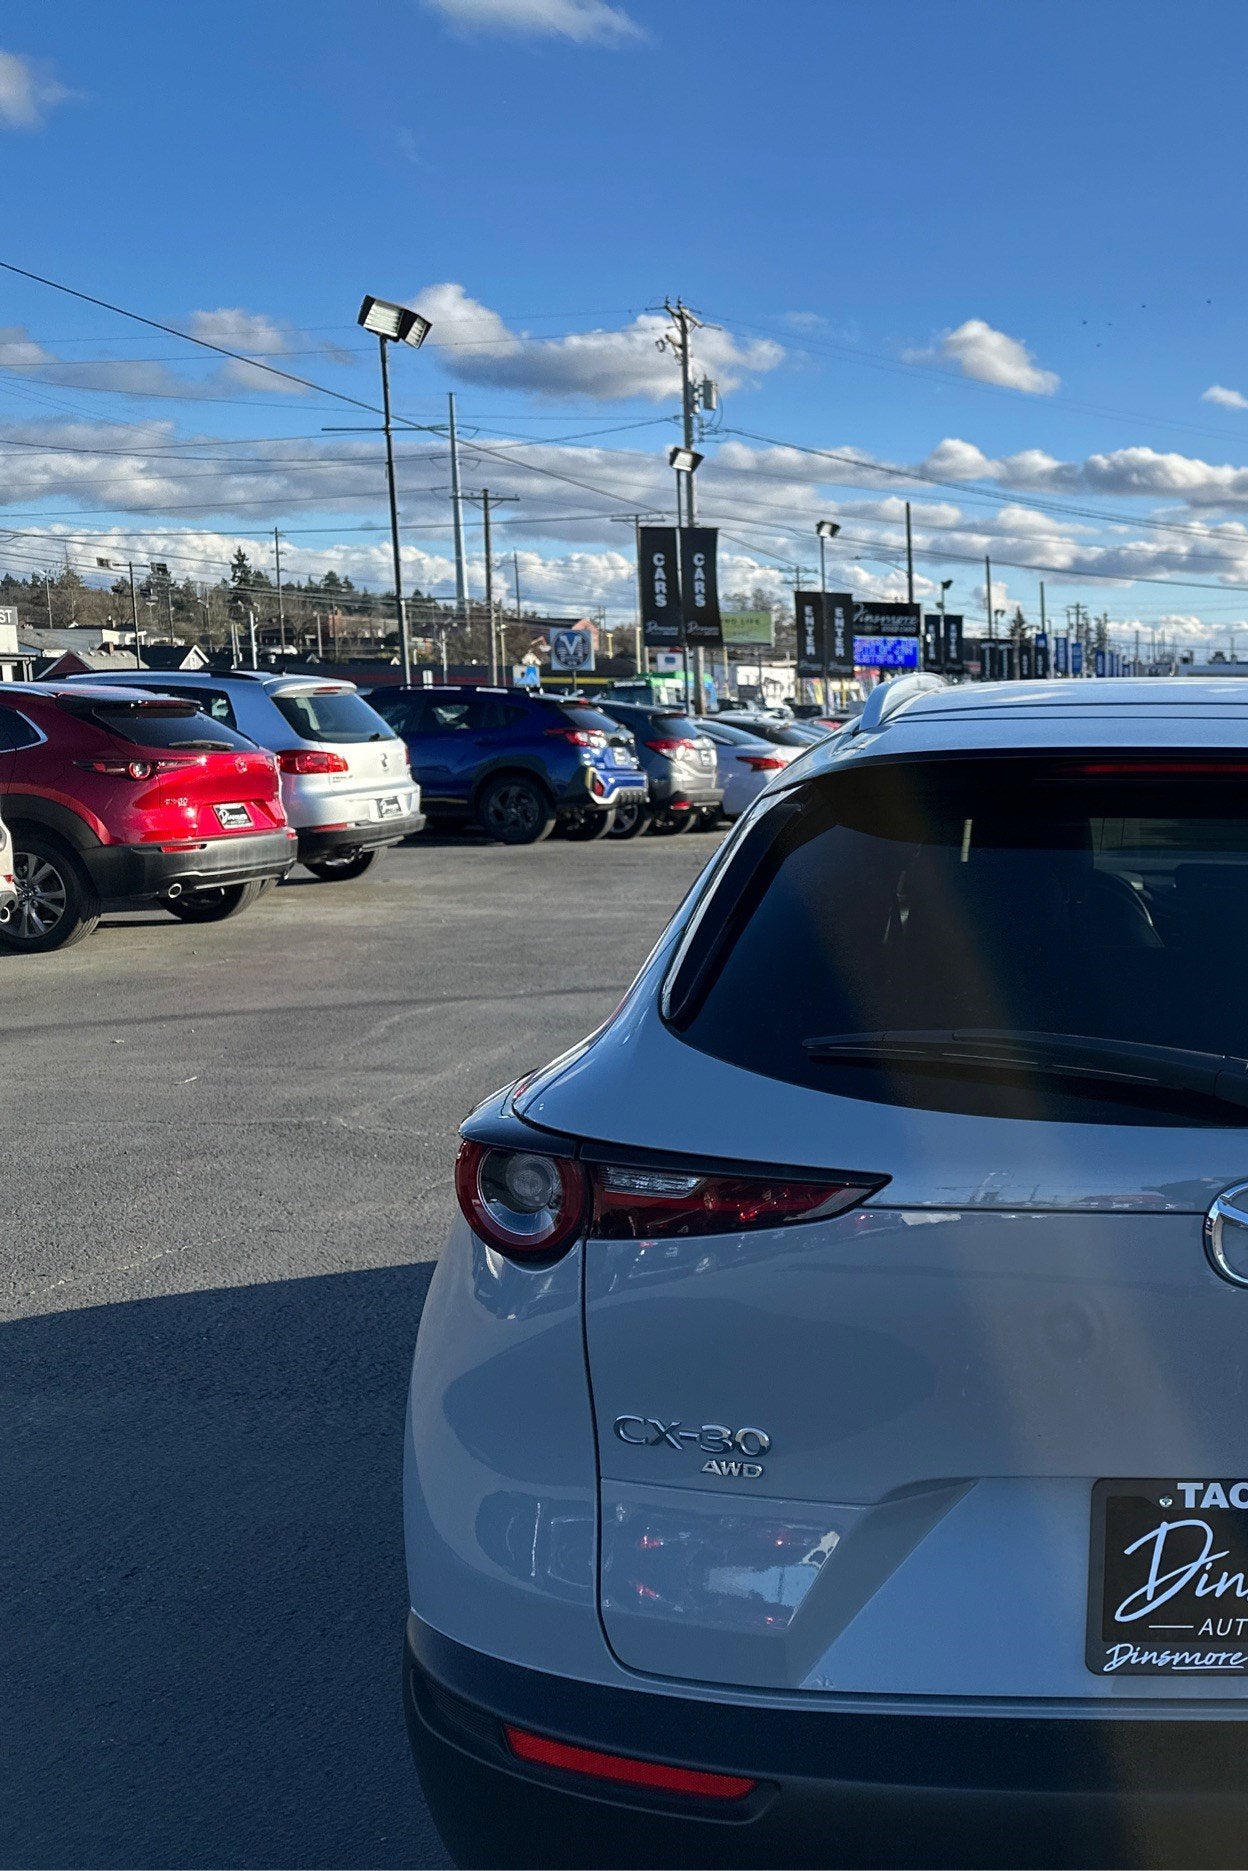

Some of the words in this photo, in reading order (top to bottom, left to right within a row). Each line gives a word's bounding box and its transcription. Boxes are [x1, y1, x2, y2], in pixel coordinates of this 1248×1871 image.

[653, 552, 668, 608] CARS
[693, 552, 706, 608] CARS
[804, 604, 816, 656] ENTER
[834, 606, 845, 658] ENTER
[613, 1414, 773, 1457] CX-30
[701, 1458, 764, 1479] AWD
[1102, 1643, 1248, 1672] Dinsmore
